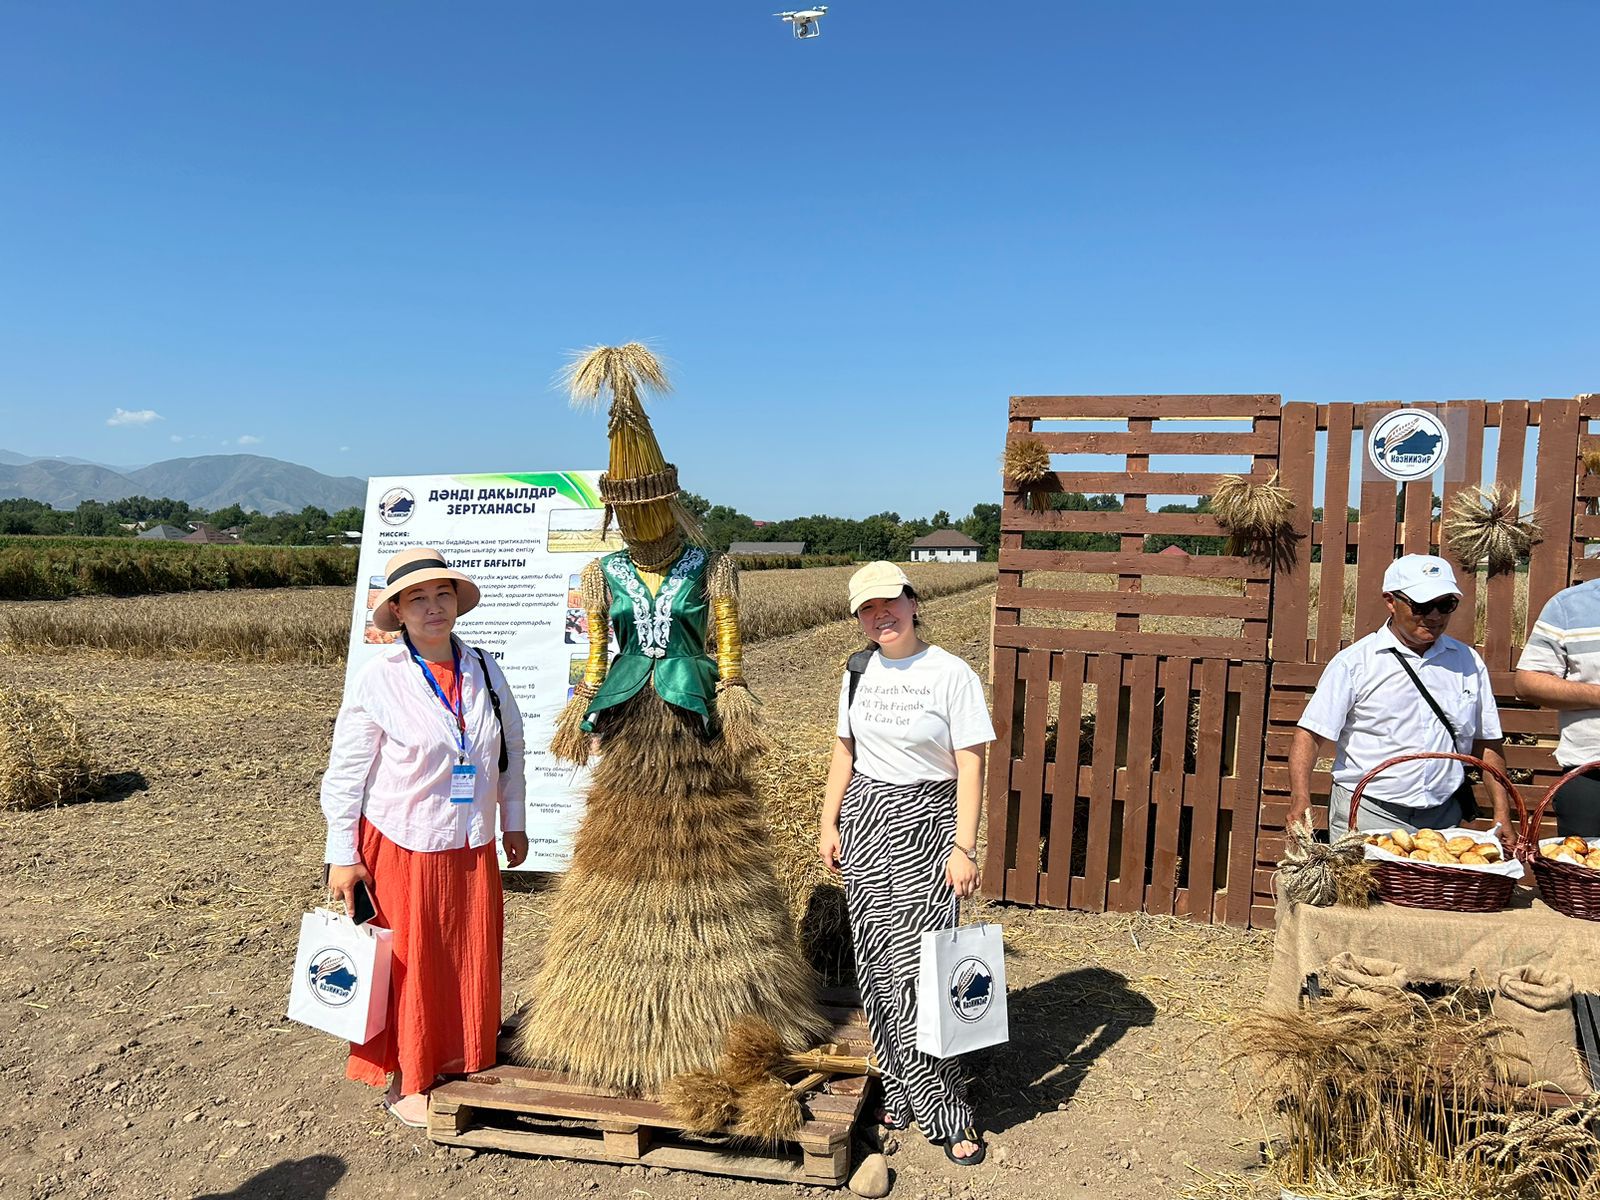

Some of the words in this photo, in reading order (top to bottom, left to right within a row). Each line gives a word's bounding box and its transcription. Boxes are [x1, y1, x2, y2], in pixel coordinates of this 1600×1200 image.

[428, 489, 474, 502] ДӘНДІ
[478, 486, 557, 500] ДАҚЫЛДАР
[446, 502, 536, 515] ЗЕРТХАНАСЫ
[446, 560, 481, 568] ЫЗМЕТ
[484, 558, 526, 568] БАҒЫТЫ
[874, 686, 898, 694] Earth
[902, 685, 931, 696] Needs
[891, 701, 924, 711] Friends
[864, 712, 872, 721] It
[874, 714, 892, 724] Can
[896, 716, 910, 726] Get
